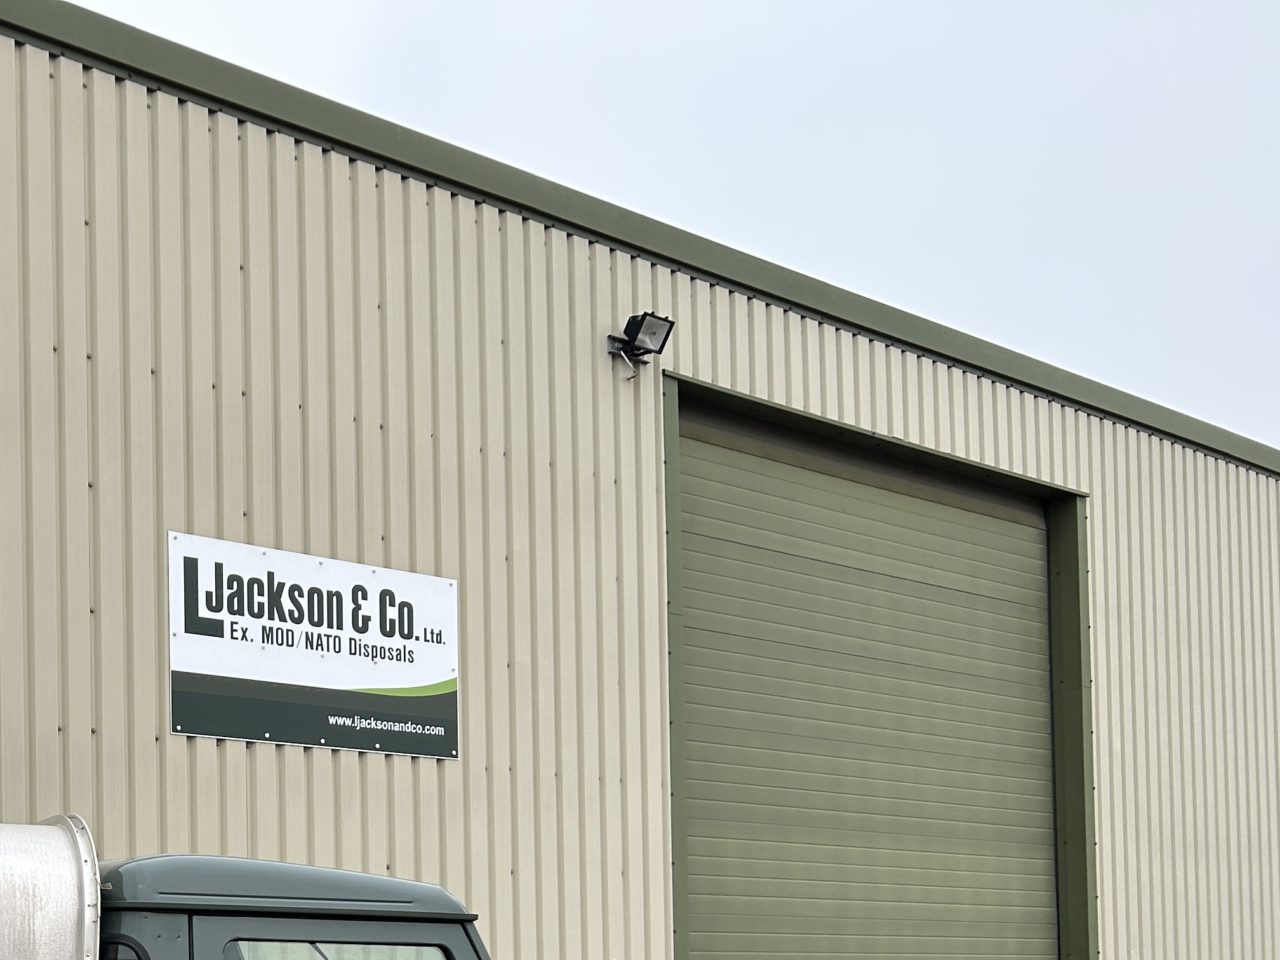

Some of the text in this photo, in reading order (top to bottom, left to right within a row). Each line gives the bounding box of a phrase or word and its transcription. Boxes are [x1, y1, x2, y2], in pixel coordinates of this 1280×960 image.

[351, 584, 371, 634] &
[379, 588, 420, 641] Co.
[424, 627, 446, 645] Ltd.
[230, 621, 415, 663] Ex. MOD/NATO Disposals
[328, 713, 445, 736] www.ljacksonandco.com
